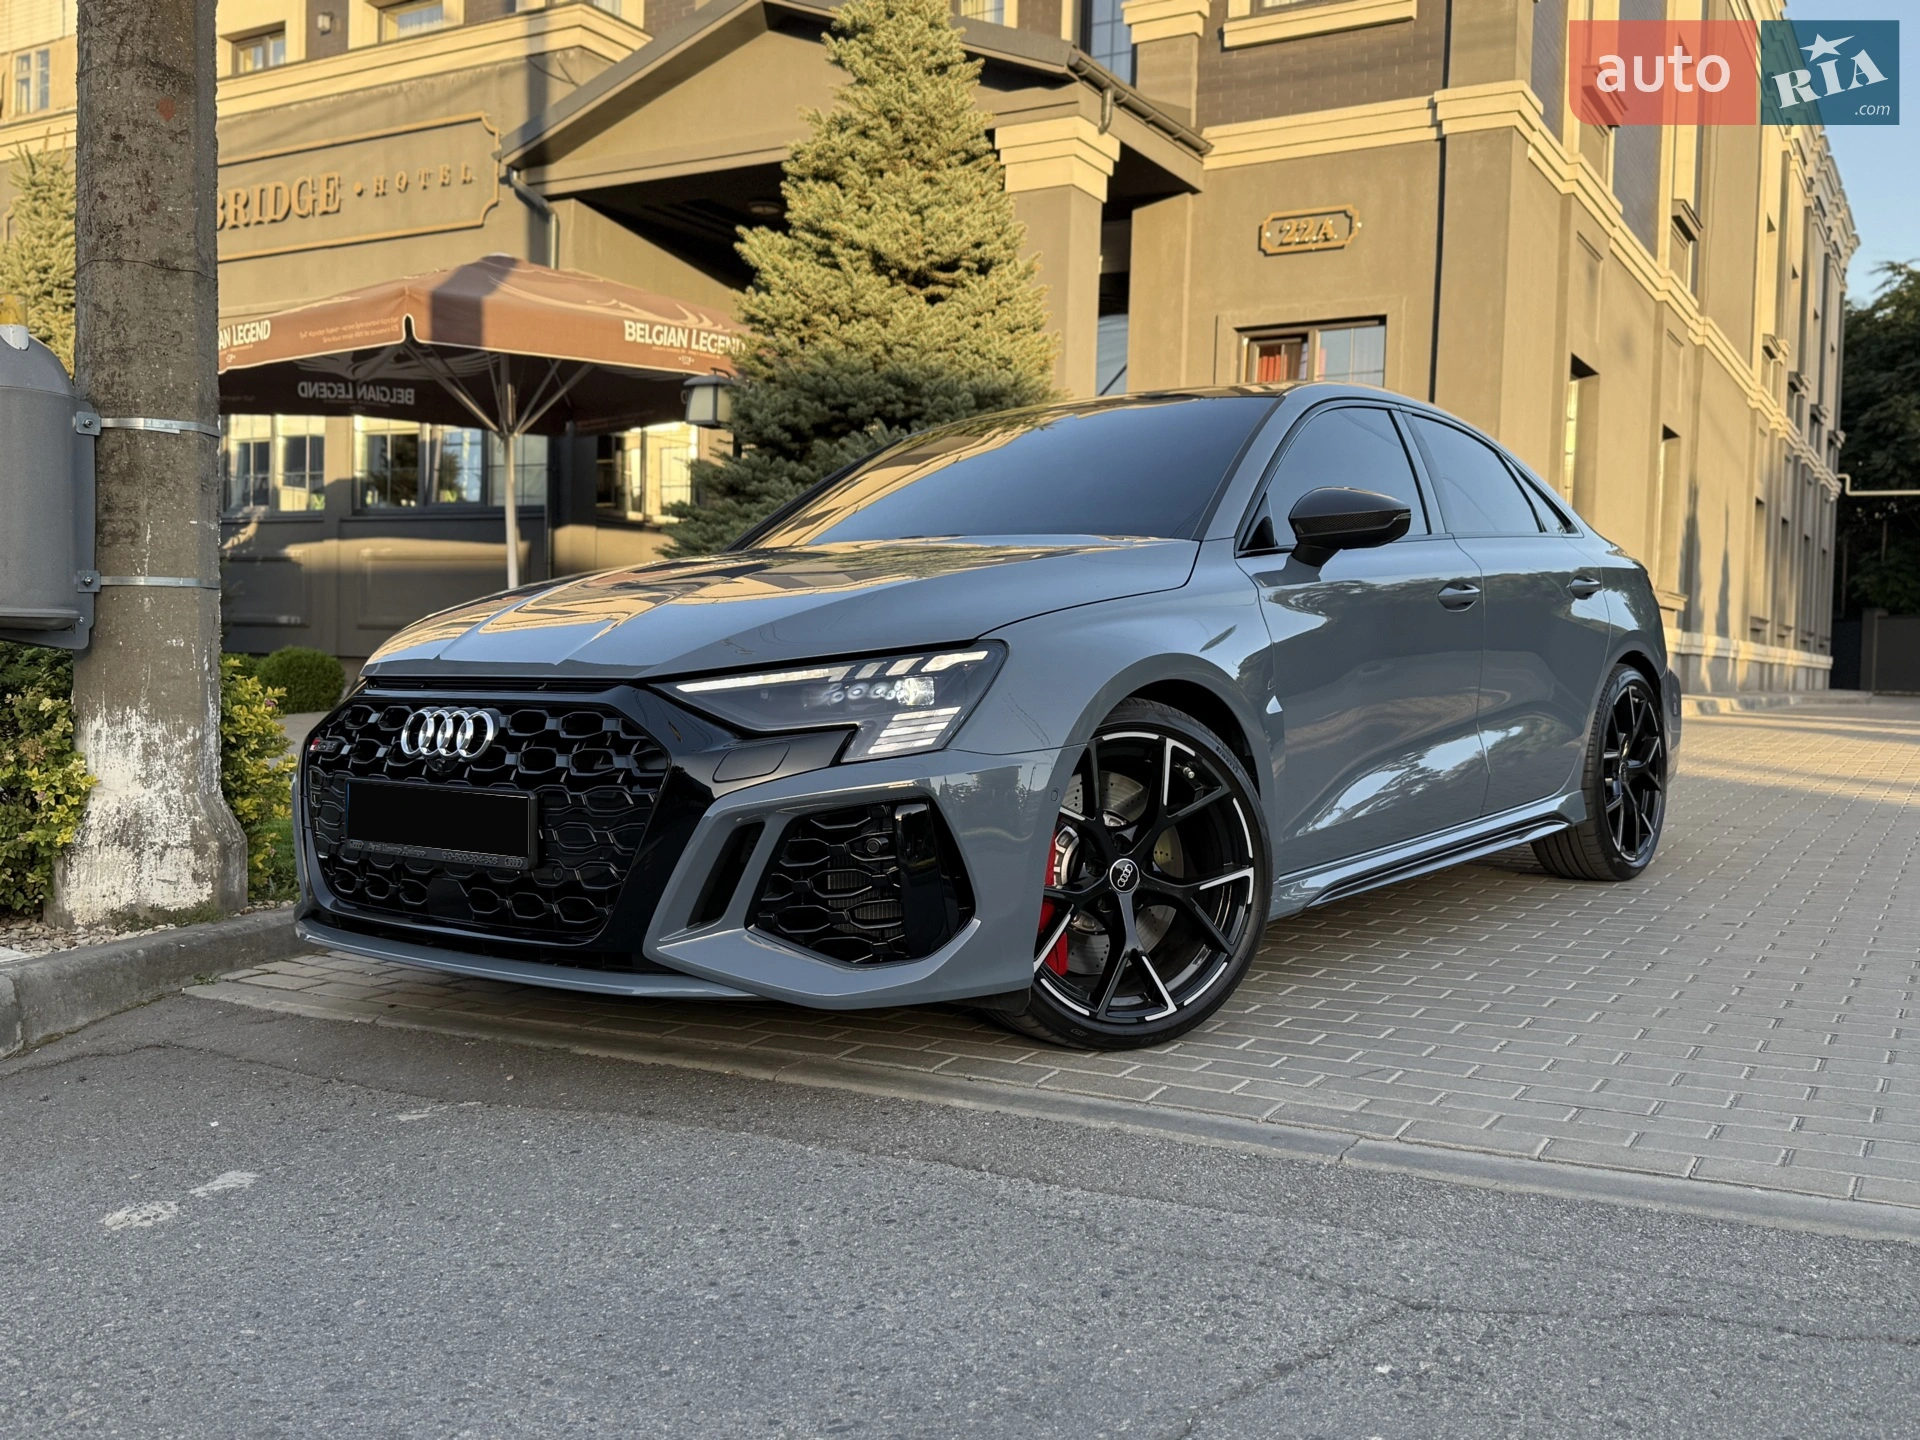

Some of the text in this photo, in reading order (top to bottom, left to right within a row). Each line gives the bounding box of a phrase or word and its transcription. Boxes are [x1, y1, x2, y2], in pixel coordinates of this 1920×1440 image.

[373, 162, 473, 198] HOTEL
[1279, 216, 1337, 247] 22A
[232, 319, 271, 346] LEGEND
[624, 320, 689, 349] BELGIAN
